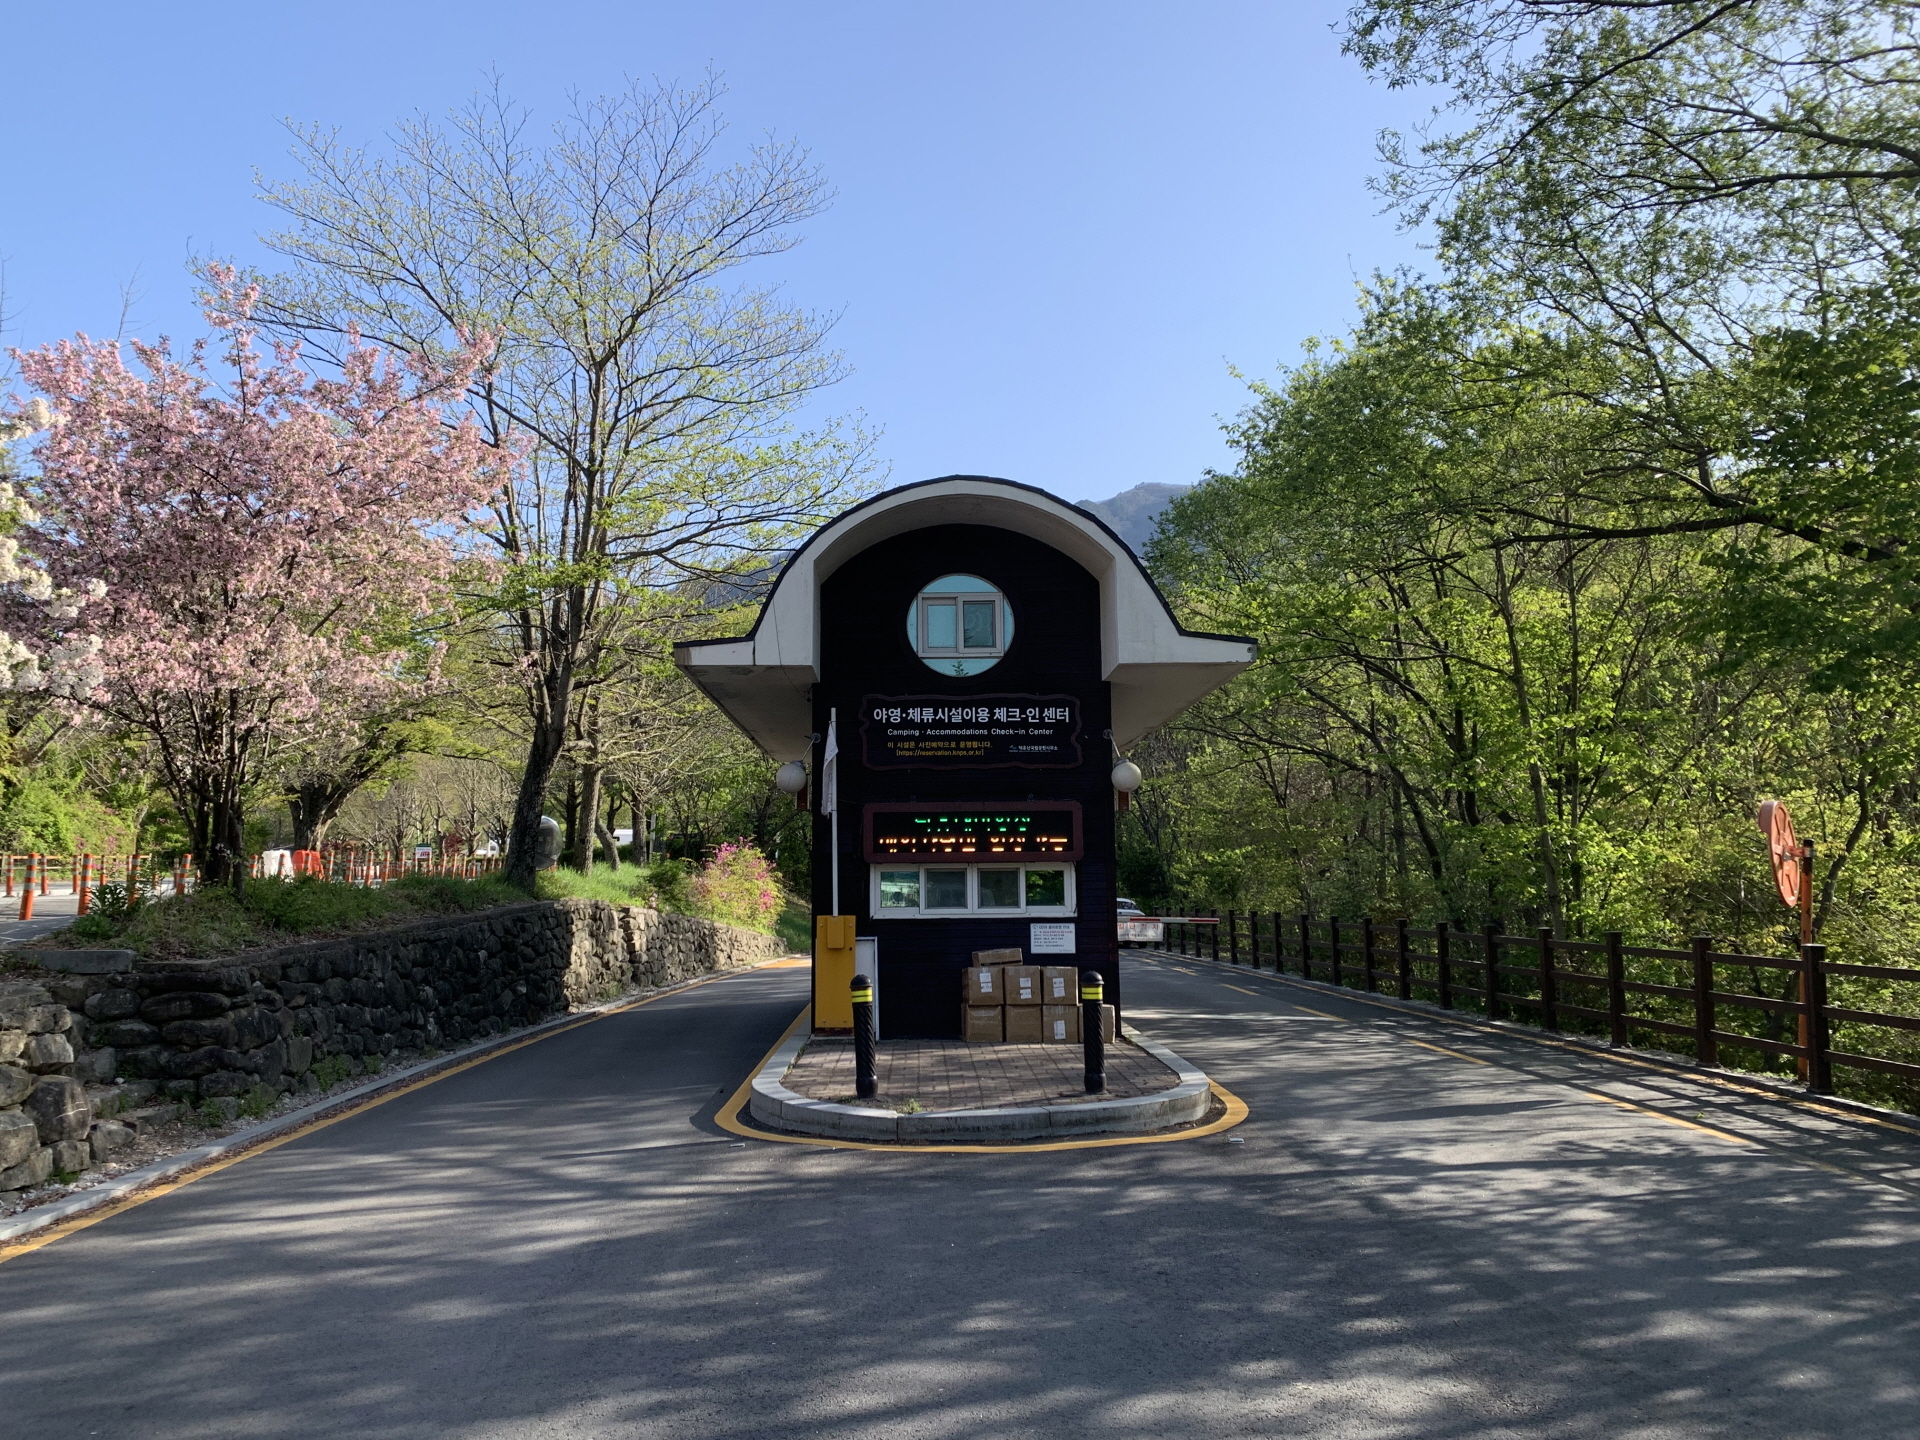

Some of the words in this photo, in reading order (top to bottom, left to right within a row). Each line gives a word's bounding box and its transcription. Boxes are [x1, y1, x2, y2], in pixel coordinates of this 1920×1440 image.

[873, 707, 990, 724] 야영·체류시설이용
[993, 707, 1040, 723] 체크-인
[1042, 707, 1070, 723] 센터
[887, 728, 920, 737] Camping
[926, 728, 988, 736] Accommodations
[897, 741, 916, 749] 시설은
